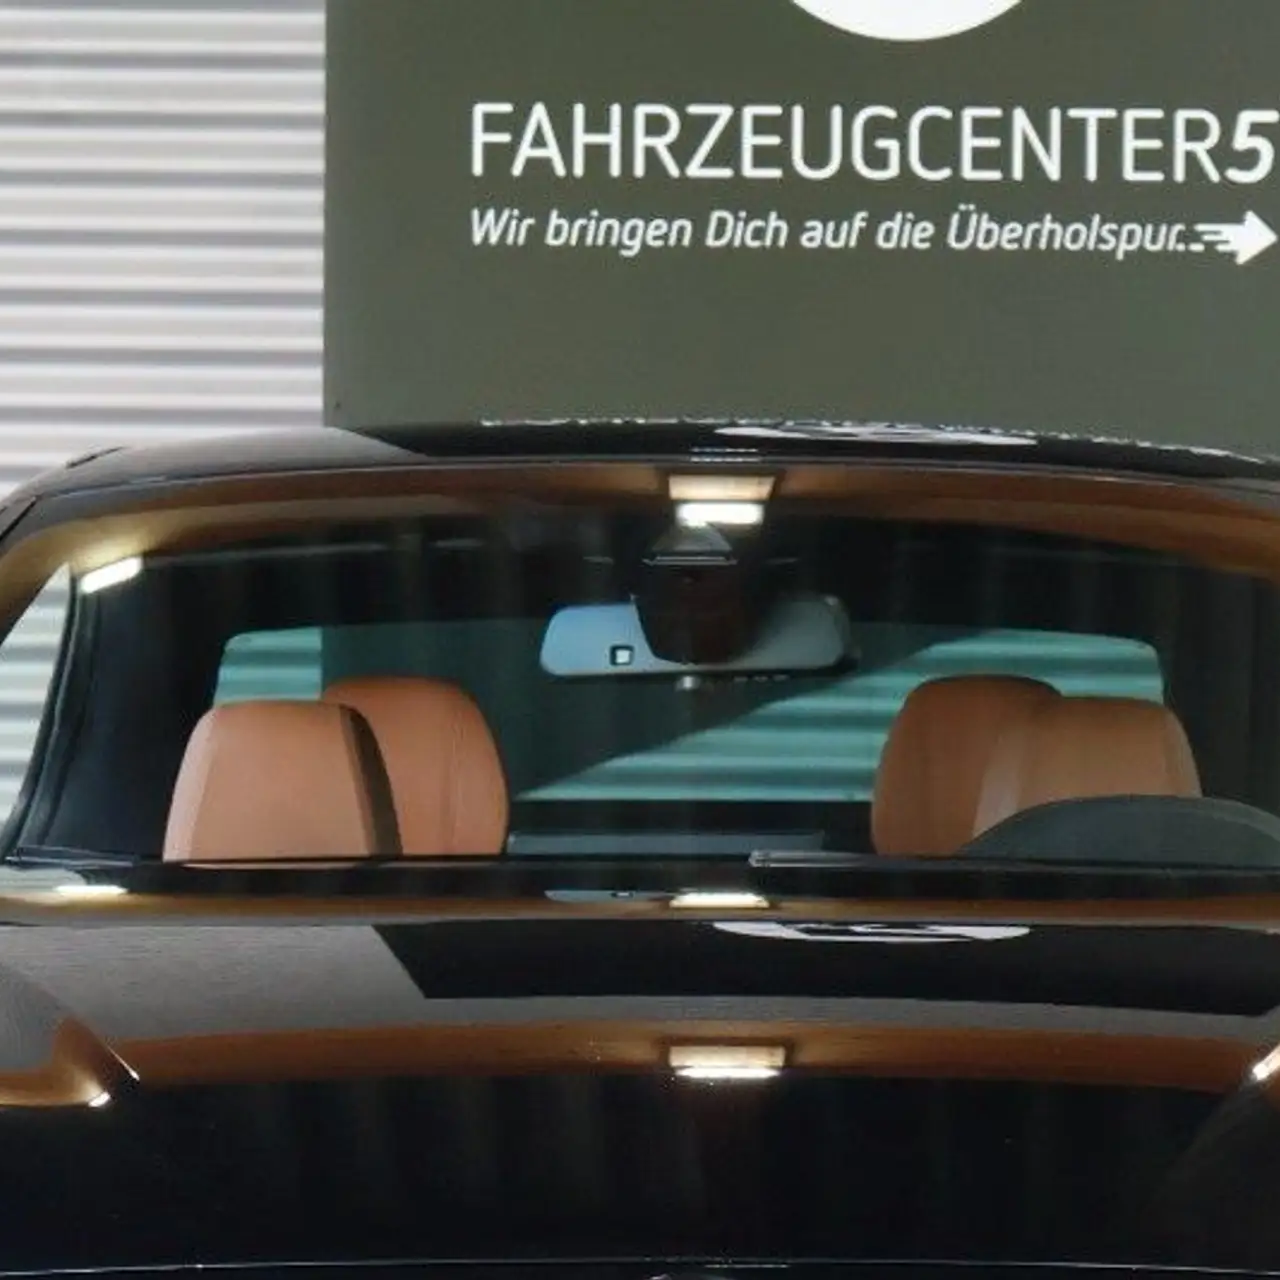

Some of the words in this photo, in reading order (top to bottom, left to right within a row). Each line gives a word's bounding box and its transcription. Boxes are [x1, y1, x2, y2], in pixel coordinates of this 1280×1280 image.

[469, 208, 536, 247] Wir
[544, 208, 693, 258] bringen
[705, 209, 789, 248] Dich
[799, 211, 869, 249] auf
[875, 211, 936, 250] die
